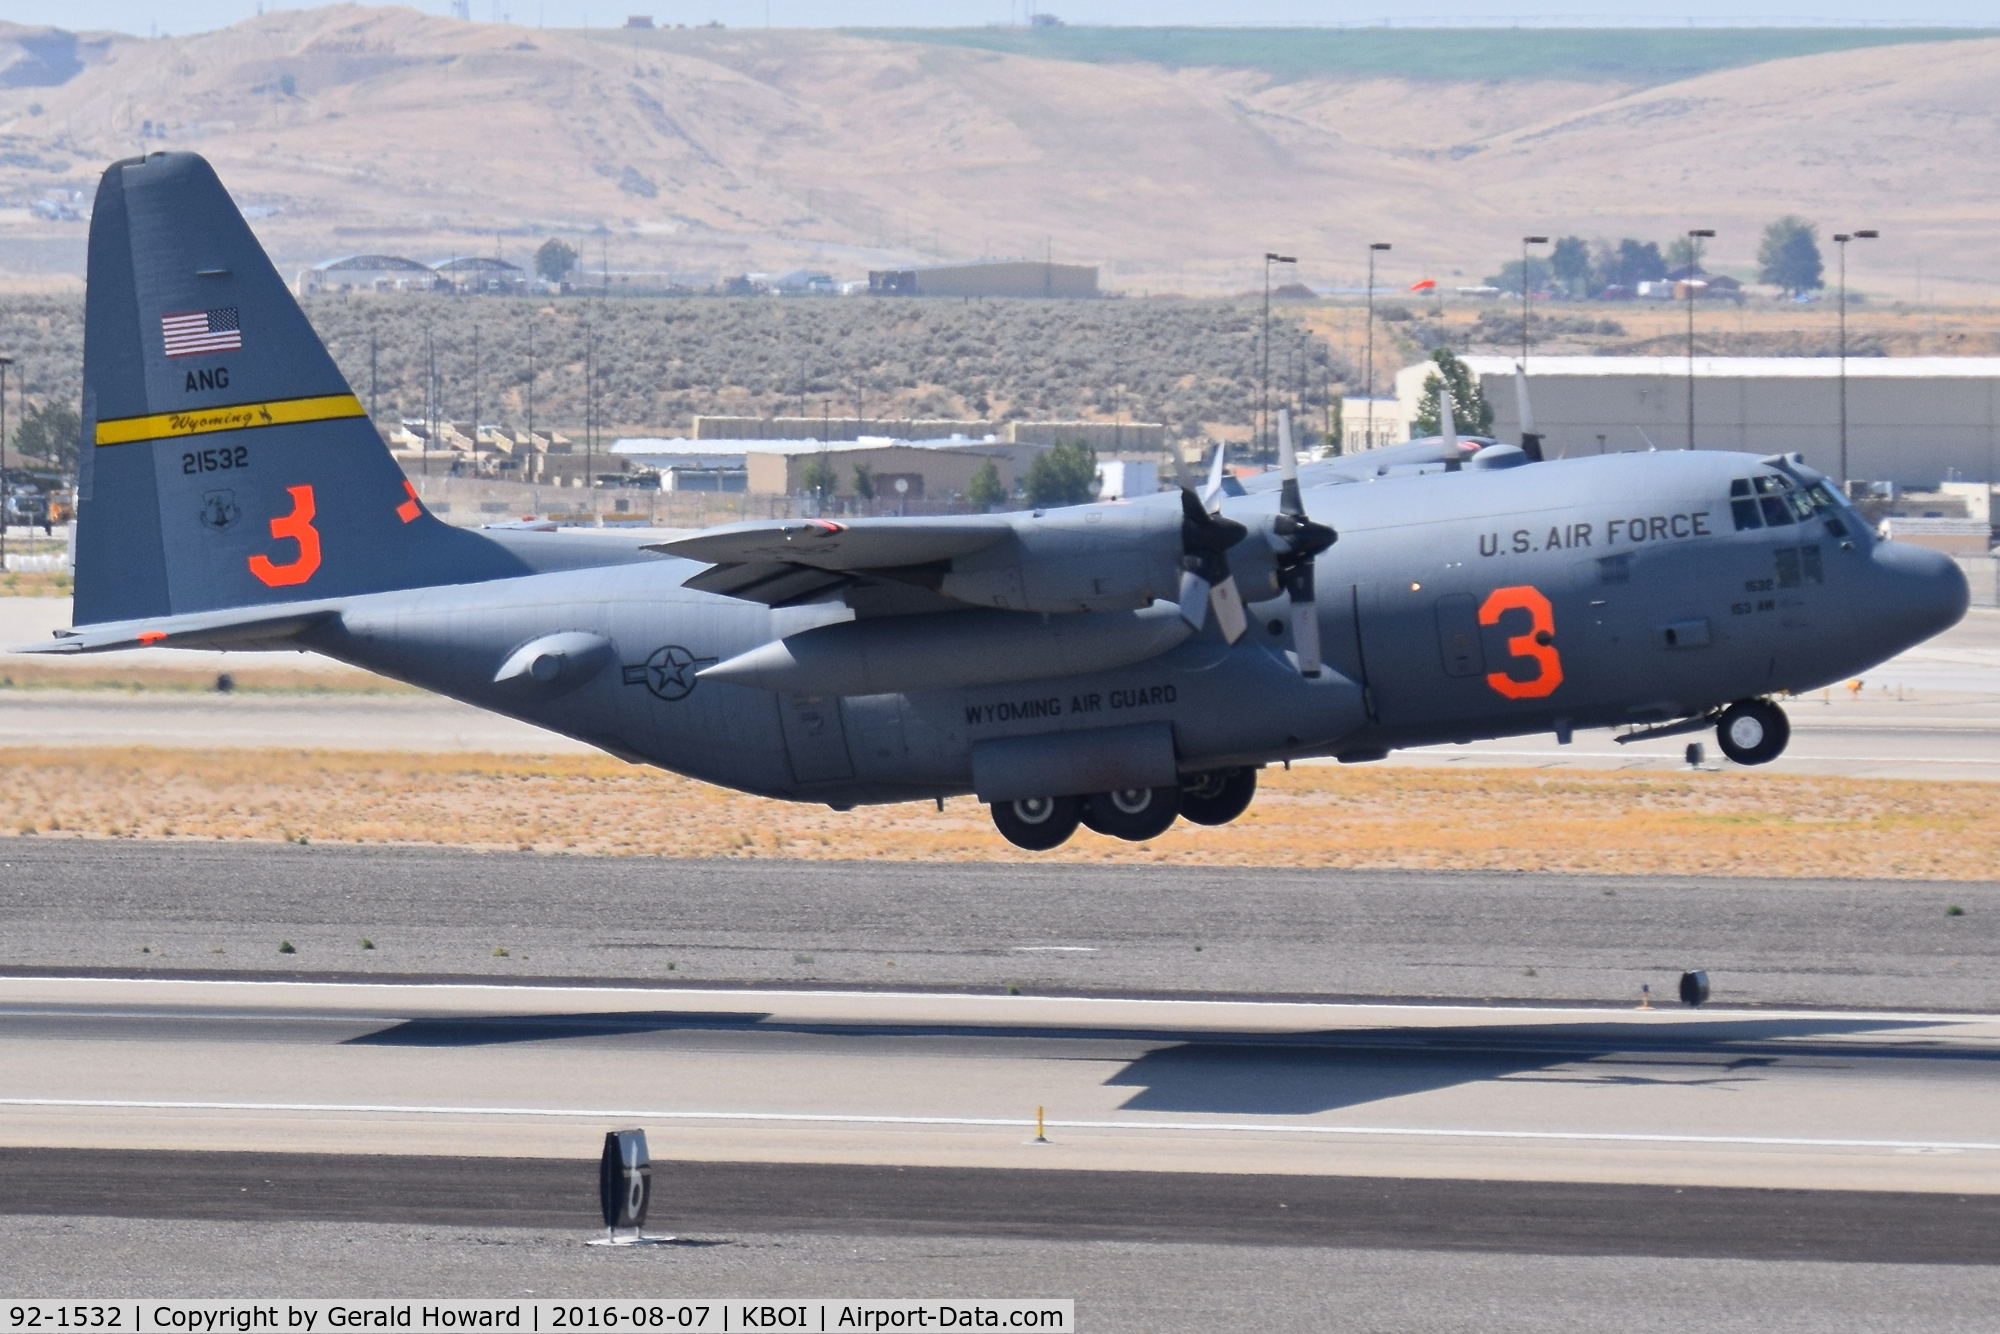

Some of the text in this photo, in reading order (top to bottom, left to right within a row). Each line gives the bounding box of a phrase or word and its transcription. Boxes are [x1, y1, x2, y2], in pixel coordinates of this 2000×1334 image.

[185, 366, 230, 393] ANG
[169, 412, 253, 433] Wyoming
[182, 446, 250, 475] 21532
[248, 484, 321, 587] 3
[1545, 522, 1594, 551] AIR
[1607, 511, 1712, 546] FORCE
[1477, 585, 1564, 699] 3
[965, 684, 1178, 724] WYOMING AIR GUARD
